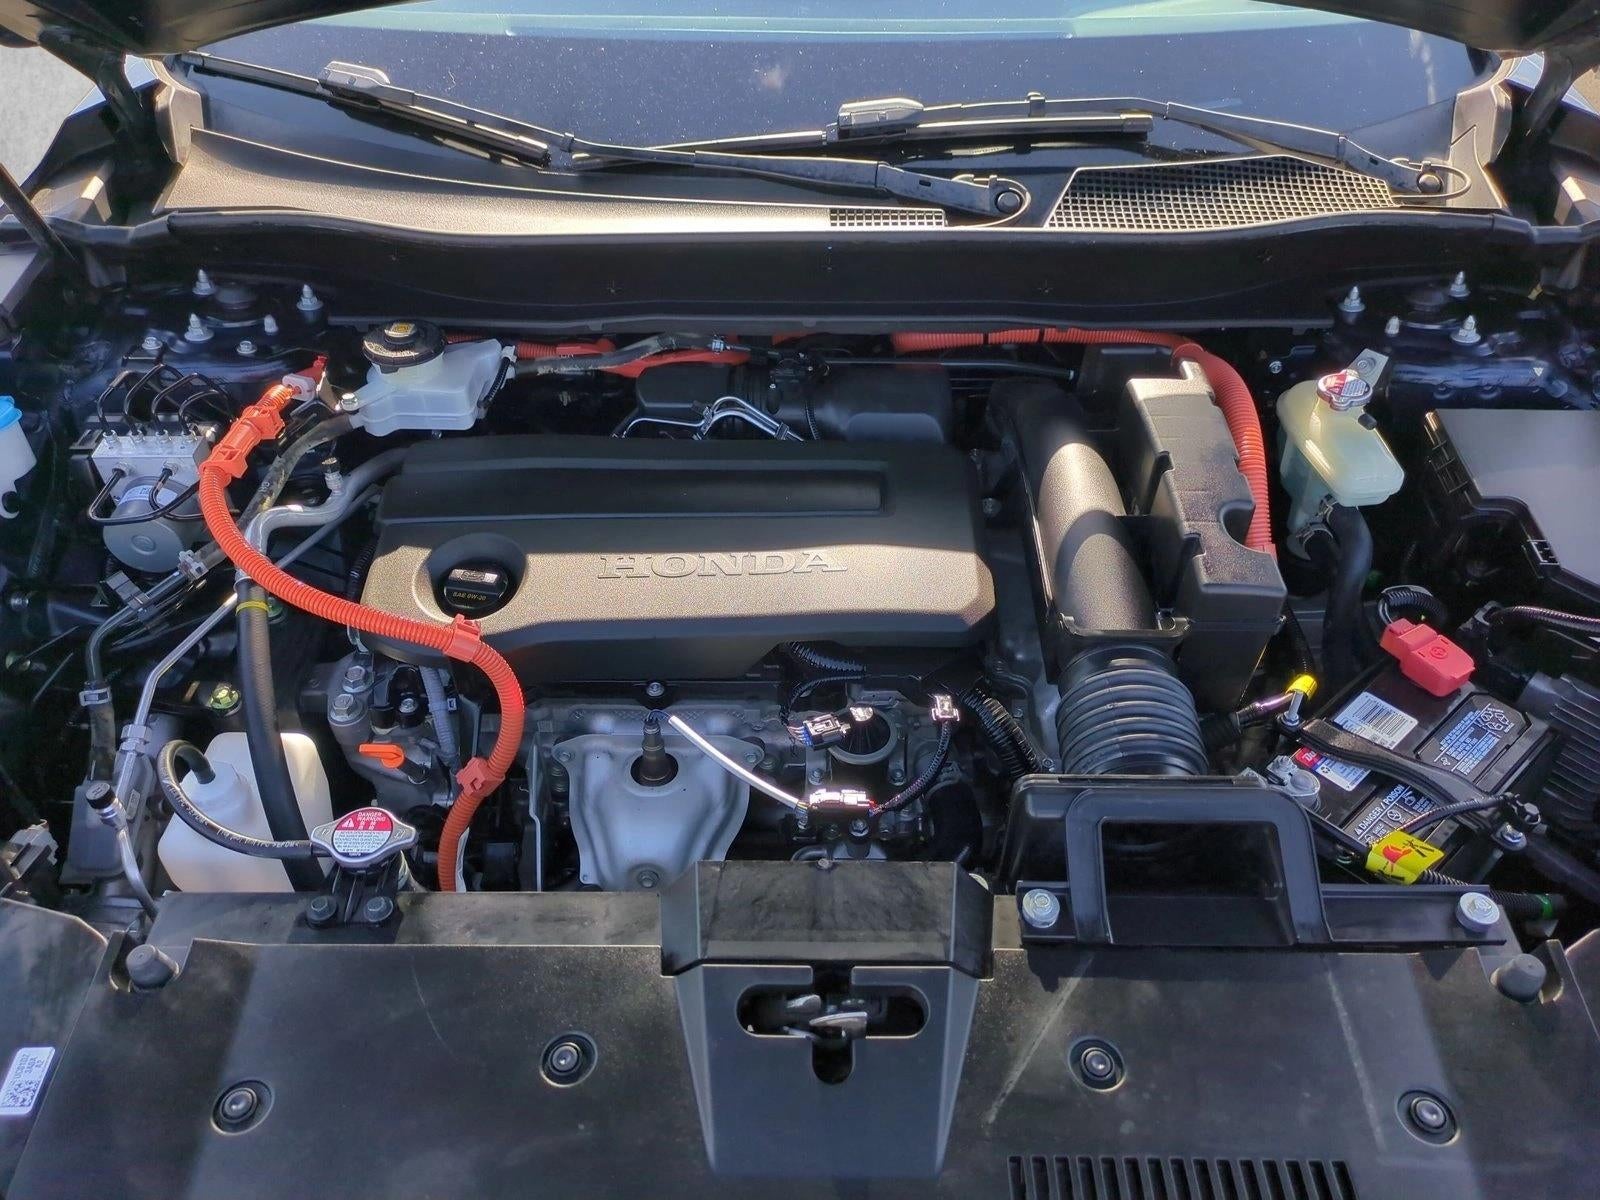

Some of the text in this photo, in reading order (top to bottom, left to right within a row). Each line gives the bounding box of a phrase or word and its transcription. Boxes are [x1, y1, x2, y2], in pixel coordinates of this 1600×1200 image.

[597, 550, 848, 579] HONDA
[452, 591, 467, 599] SAE
[1358, 804, 1384, 830] DANGER
[1383, 783, 1406, 806] POISON
